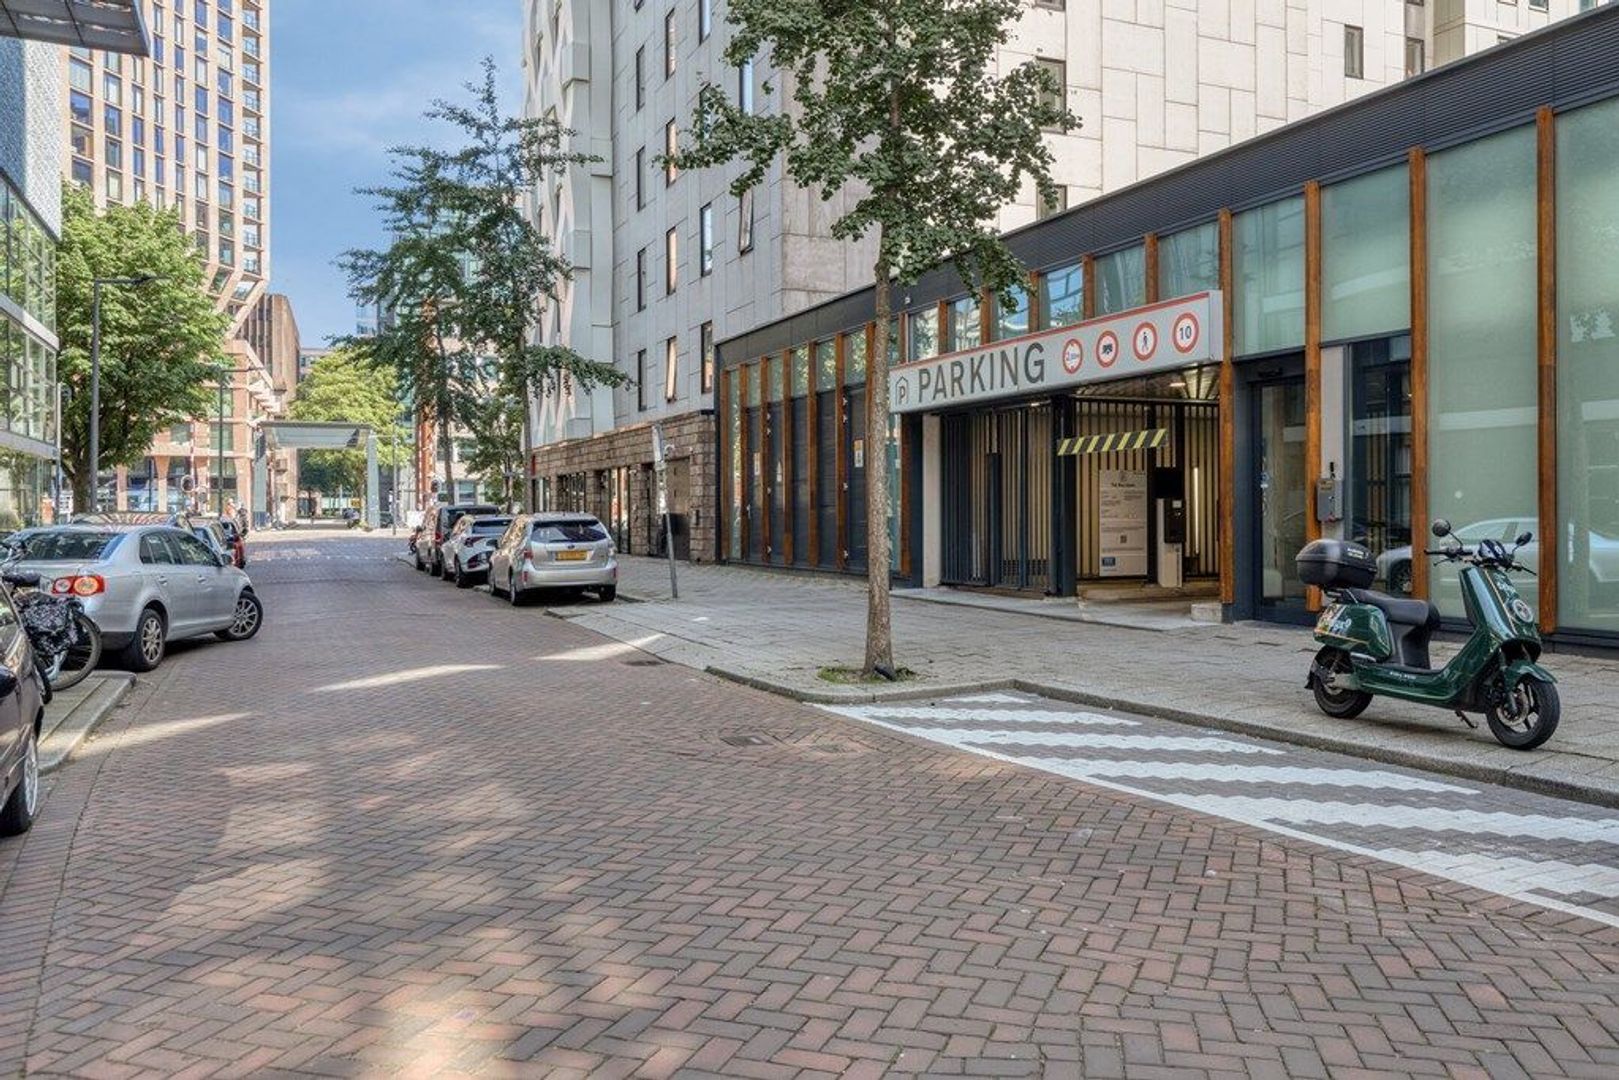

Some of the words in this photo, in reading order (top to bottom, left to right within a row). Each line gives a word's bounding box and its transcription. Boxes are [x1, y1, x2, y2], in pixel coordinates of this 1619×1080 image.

[1179, 325, 1192, 340] 10
[898, 386, 906, 404] P
[918, 341, 1045, 403] PARKING
